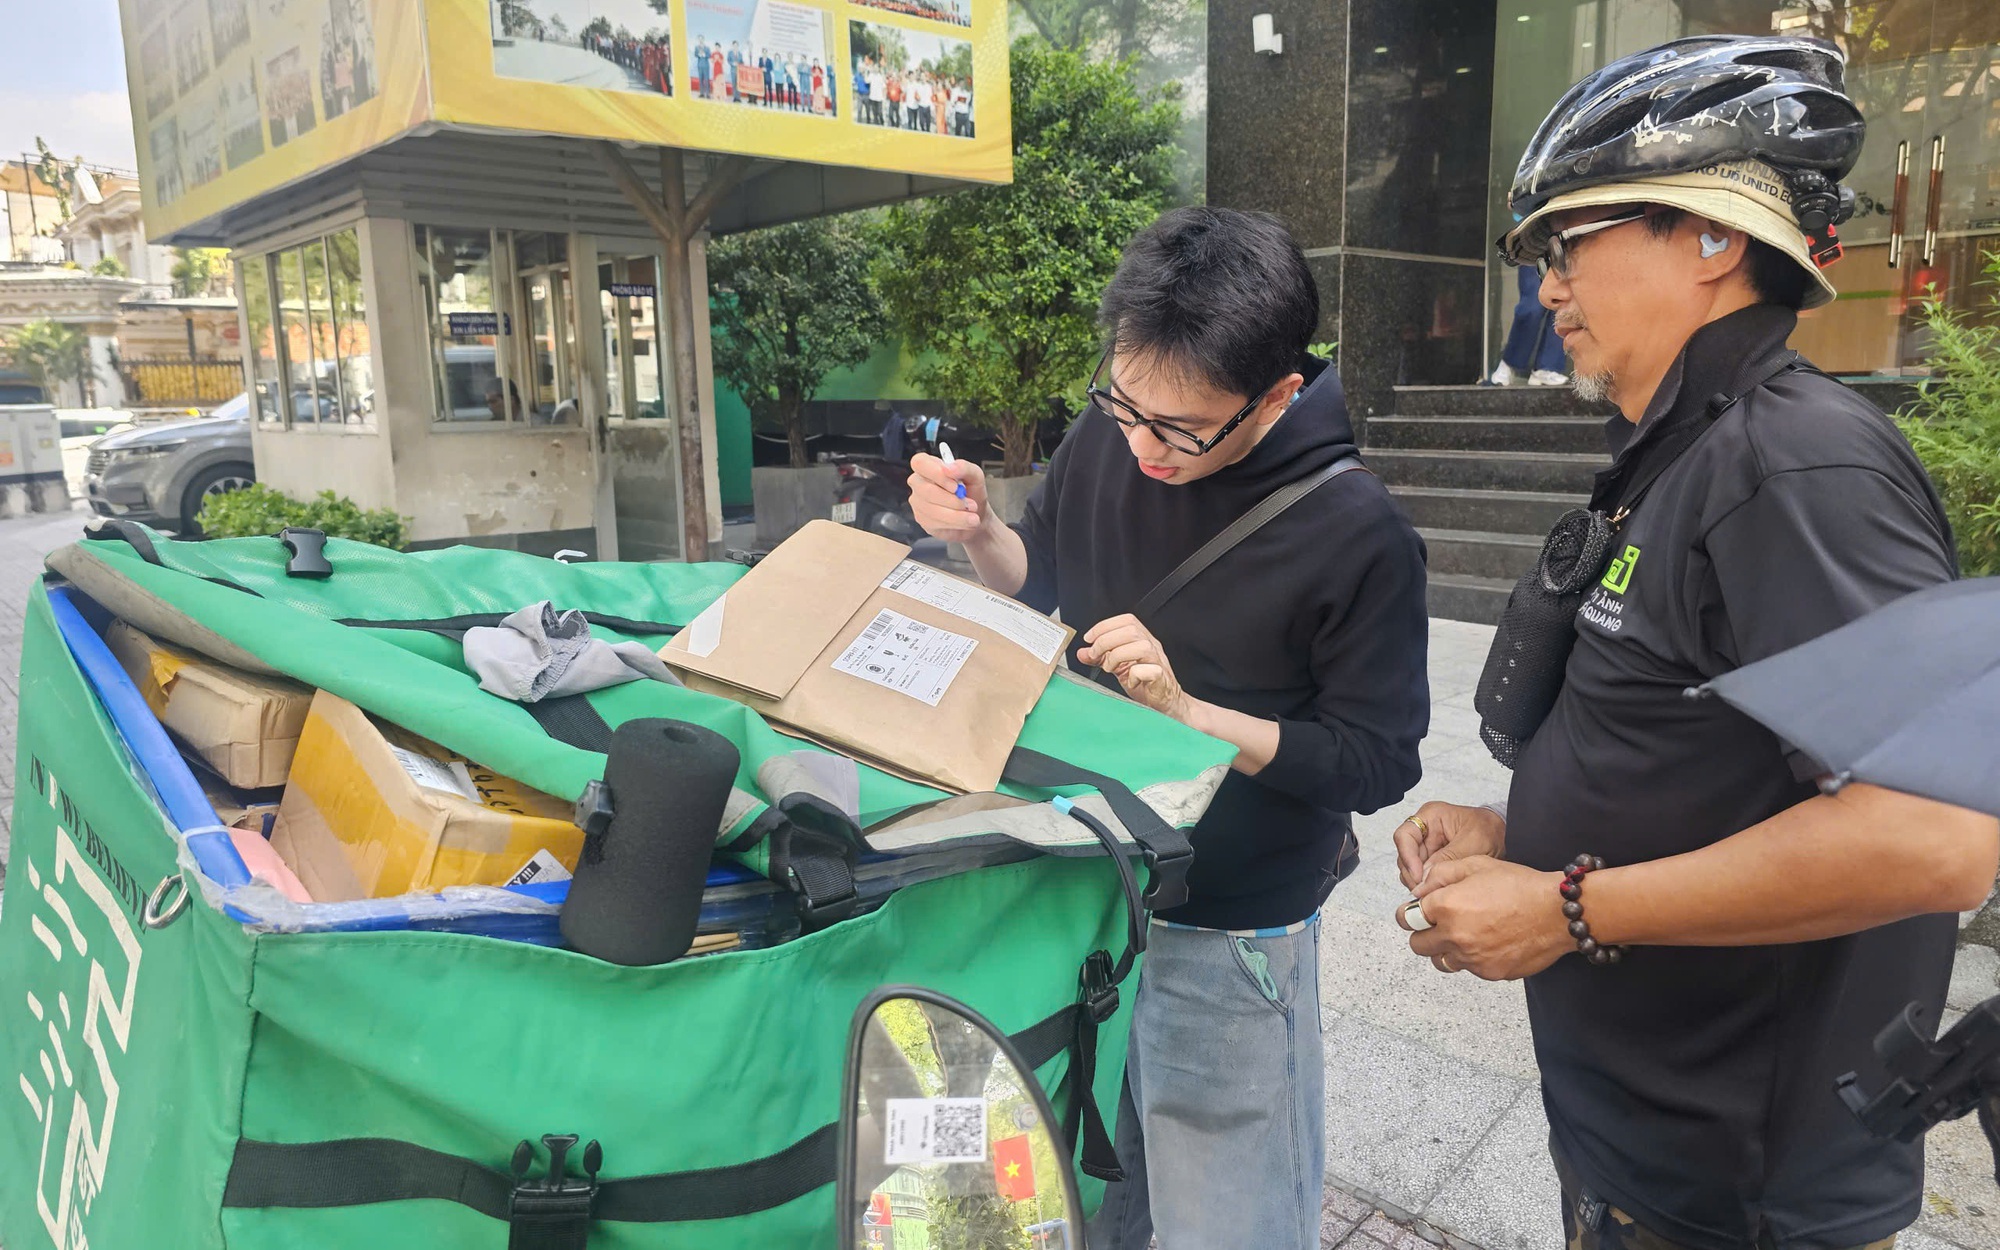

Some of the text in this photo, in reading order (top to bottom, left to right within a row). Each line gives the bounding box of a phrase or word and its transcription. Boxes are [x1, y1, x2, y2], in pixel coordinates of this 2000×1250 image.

[1742, 174, 1779, 198] UNLTD.
[1584, 605, 1622, 632] QUANG
[30, 753, 45, 796] IN
[60, 787, 82, 842] WE
